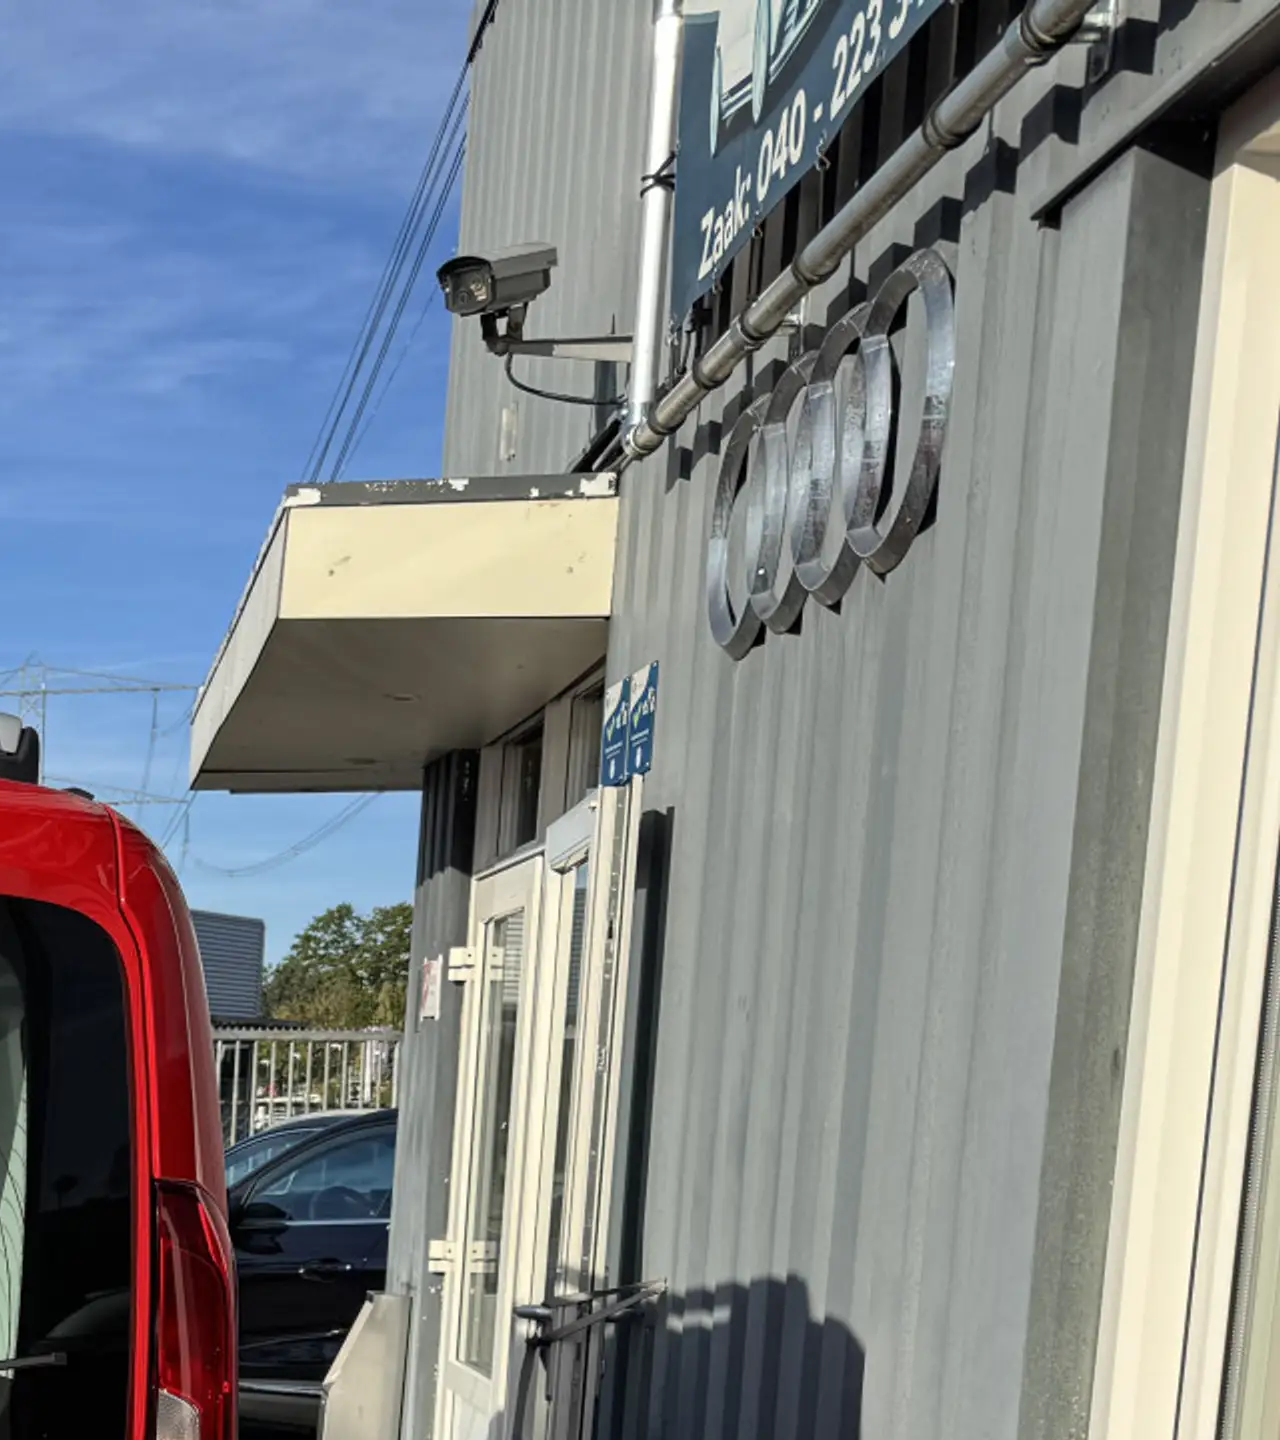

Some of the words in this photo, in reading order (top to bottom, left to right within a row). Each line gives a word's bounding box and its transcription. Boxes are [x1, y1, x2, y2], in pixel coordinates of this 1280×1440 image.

[698, 165, 752, 281] Zaak:
[756, 89, 806, 201] 040
[830, 0, 883, 121] 223
